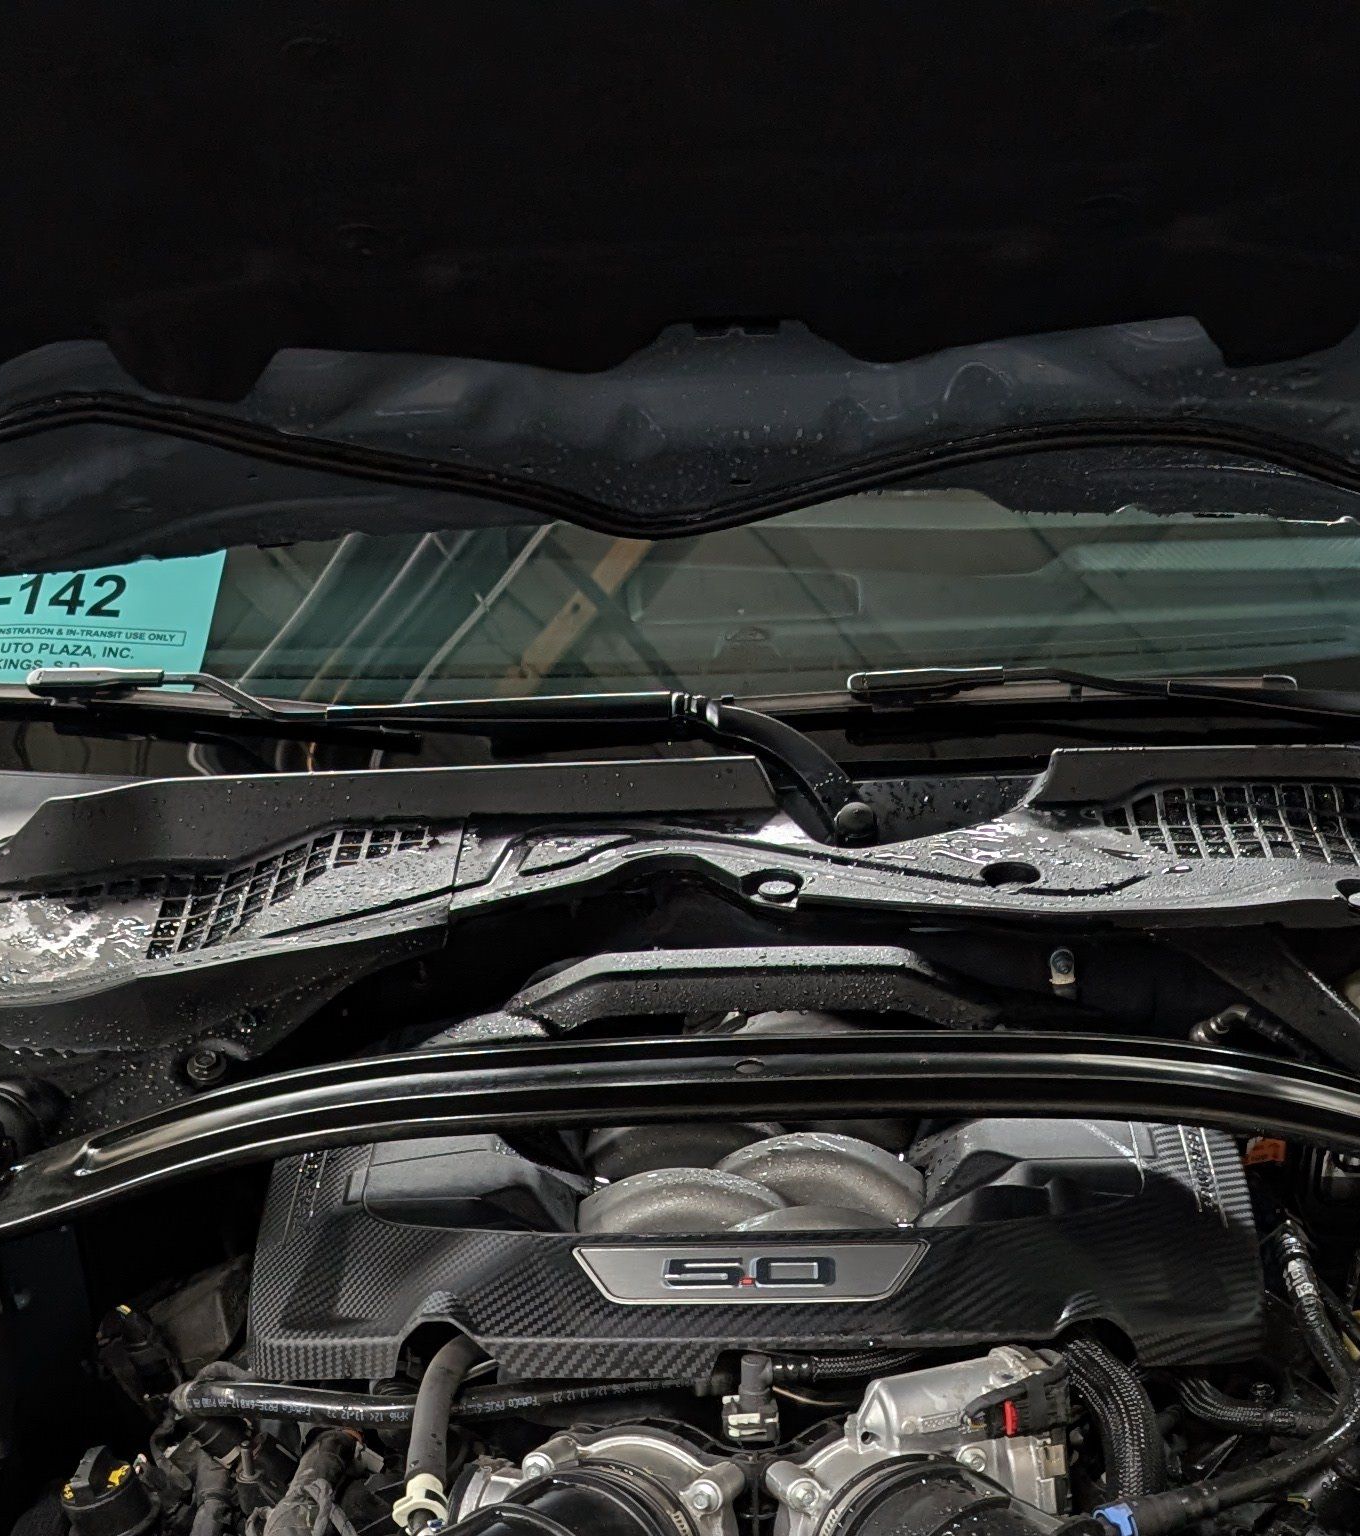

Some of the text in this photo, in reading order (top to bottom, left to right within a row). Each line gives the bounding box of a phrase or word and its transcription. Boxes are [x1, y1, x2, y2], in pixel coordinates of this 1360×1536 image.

[56, 627, 64, 636] &
[65, 628, 122, 639] IN-TRANSIT
[125, 631, 145, 641] USE
[147, 632, 177, 642] ONLY
[38, 642, 97, 659] PLAZA,
[101, 645, 135, 660] INC.
[661, 1256, 836, 1289] 5.0
